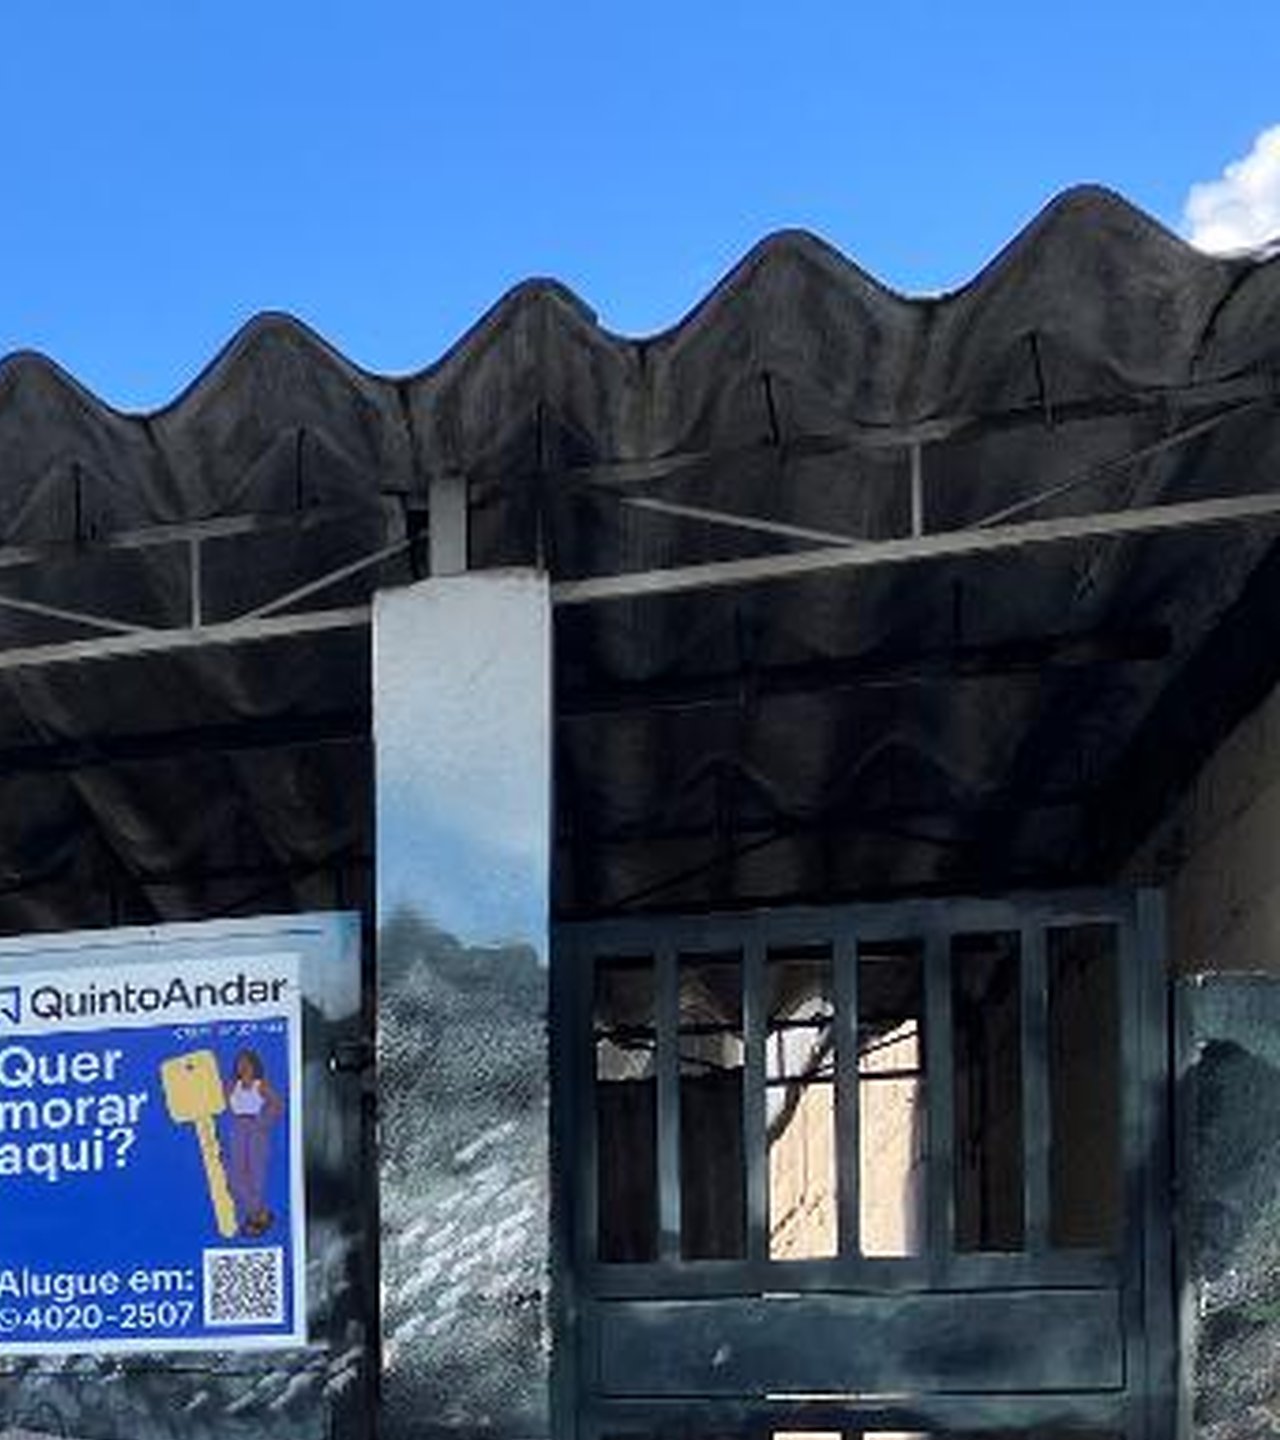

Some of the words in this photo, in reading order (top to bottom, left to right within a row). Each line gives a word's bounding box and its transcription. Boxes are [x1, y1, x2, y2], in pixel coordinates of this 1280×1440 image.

[30, 974, 288, 1021] QuintoAndar
[128, 1269, 195, 1293] em:
[23, 1300, 194, 1332] 4020-2507
